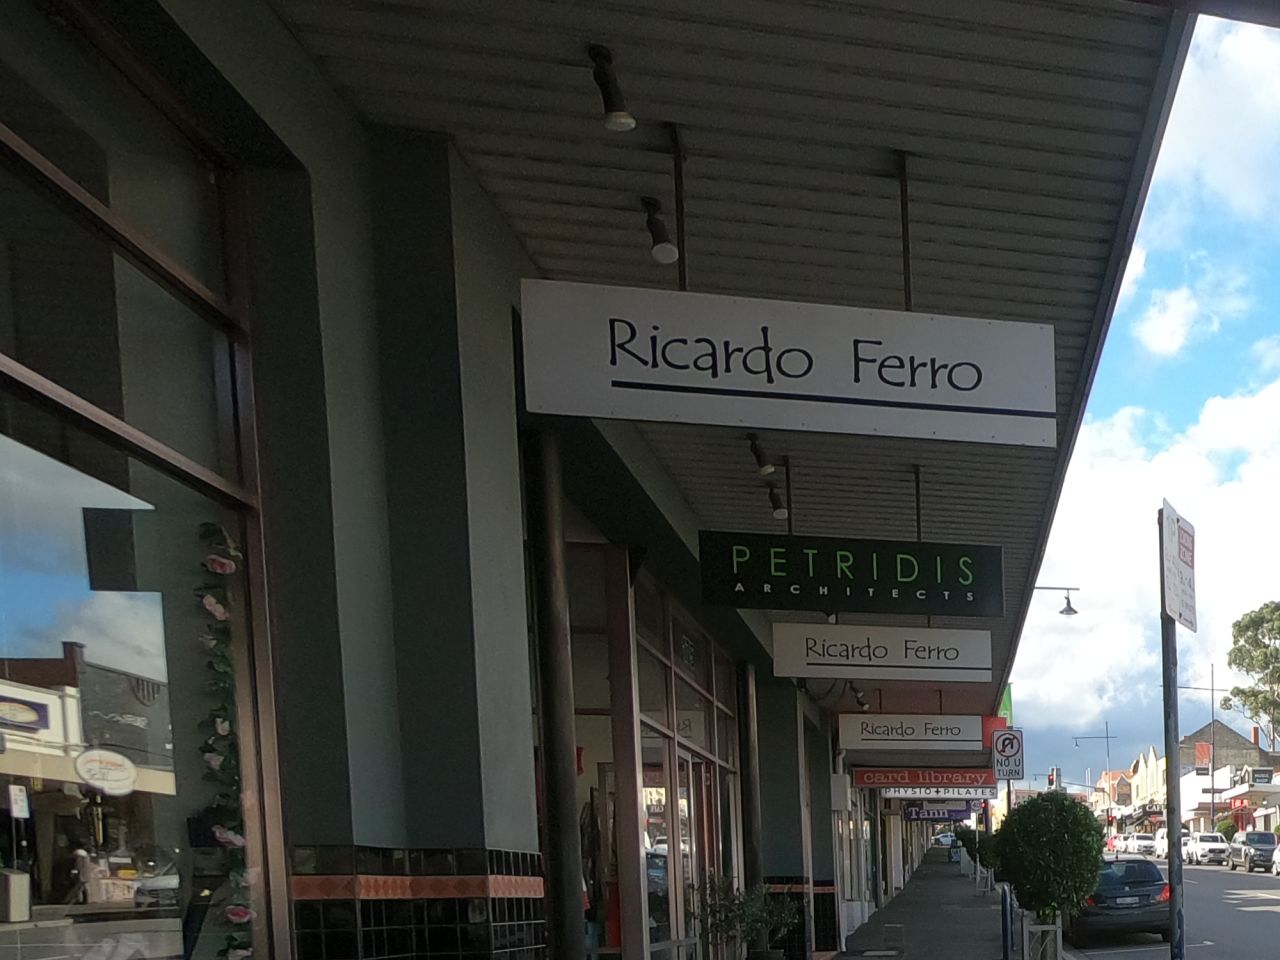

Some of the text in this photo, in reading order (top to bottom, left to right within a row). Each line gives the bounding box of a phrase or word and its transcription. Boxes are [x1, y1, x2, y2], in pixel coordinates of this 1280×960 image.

[608, 317, 984, 392] Ricardo Ferro
[731, 545, 976, 587] PETRIDIS
[734, 582, 975, 601] ARCHITECTS
[805, 637, 960, 662] Ricardo Ferro
[860, 721, 961, 738] Ricardo Ferro
[995, 758, 1021, 767] NO U
[863, 770, 988, 786] card library
[997, 769, 1021, 777] TURN
